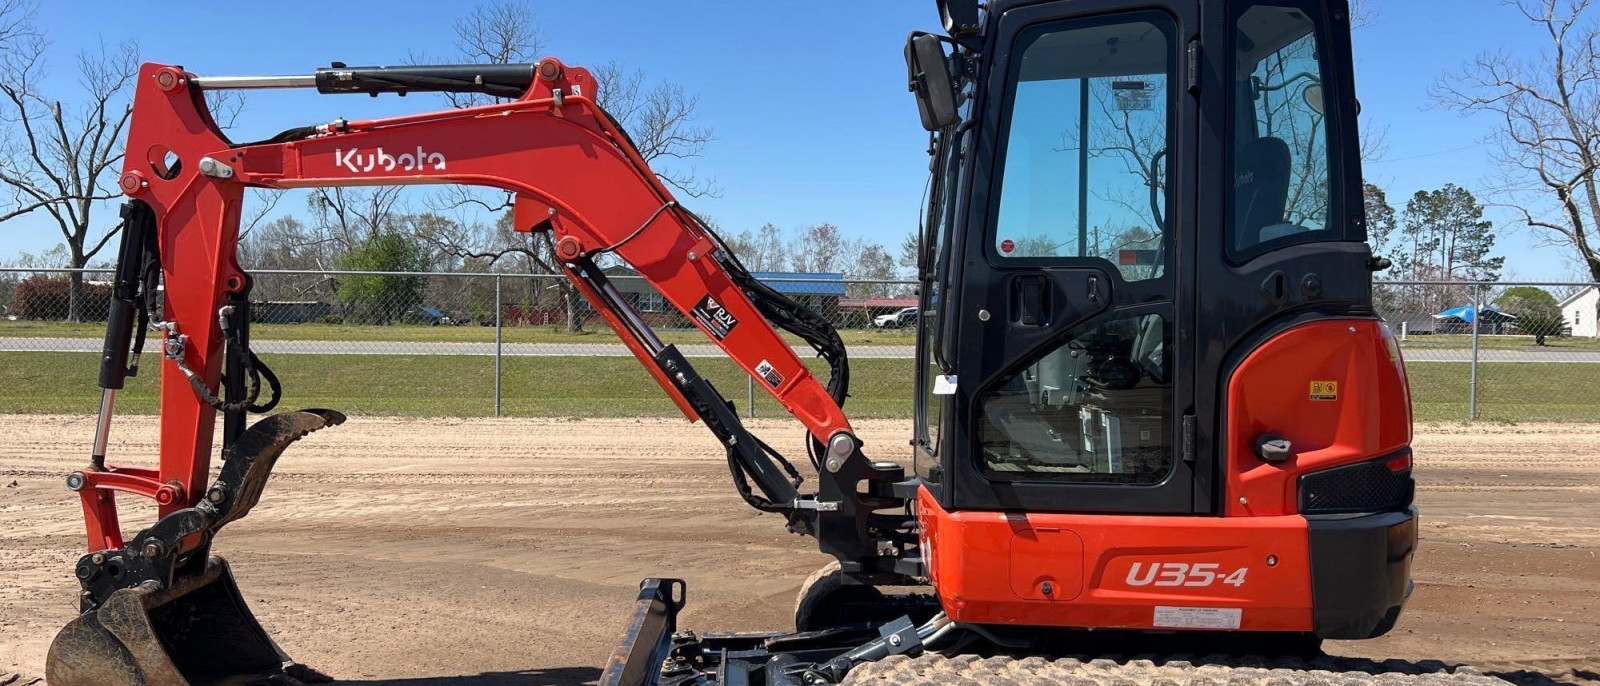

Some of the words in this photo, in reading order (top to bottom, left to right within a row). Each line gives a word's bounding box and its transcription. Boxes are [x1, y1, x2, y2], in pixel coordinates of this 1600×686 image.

[335, 145, 446, 173] Kubota
[713, 307, 736, 325] RJV
[1125, 562, 1248, 587] U35-4
